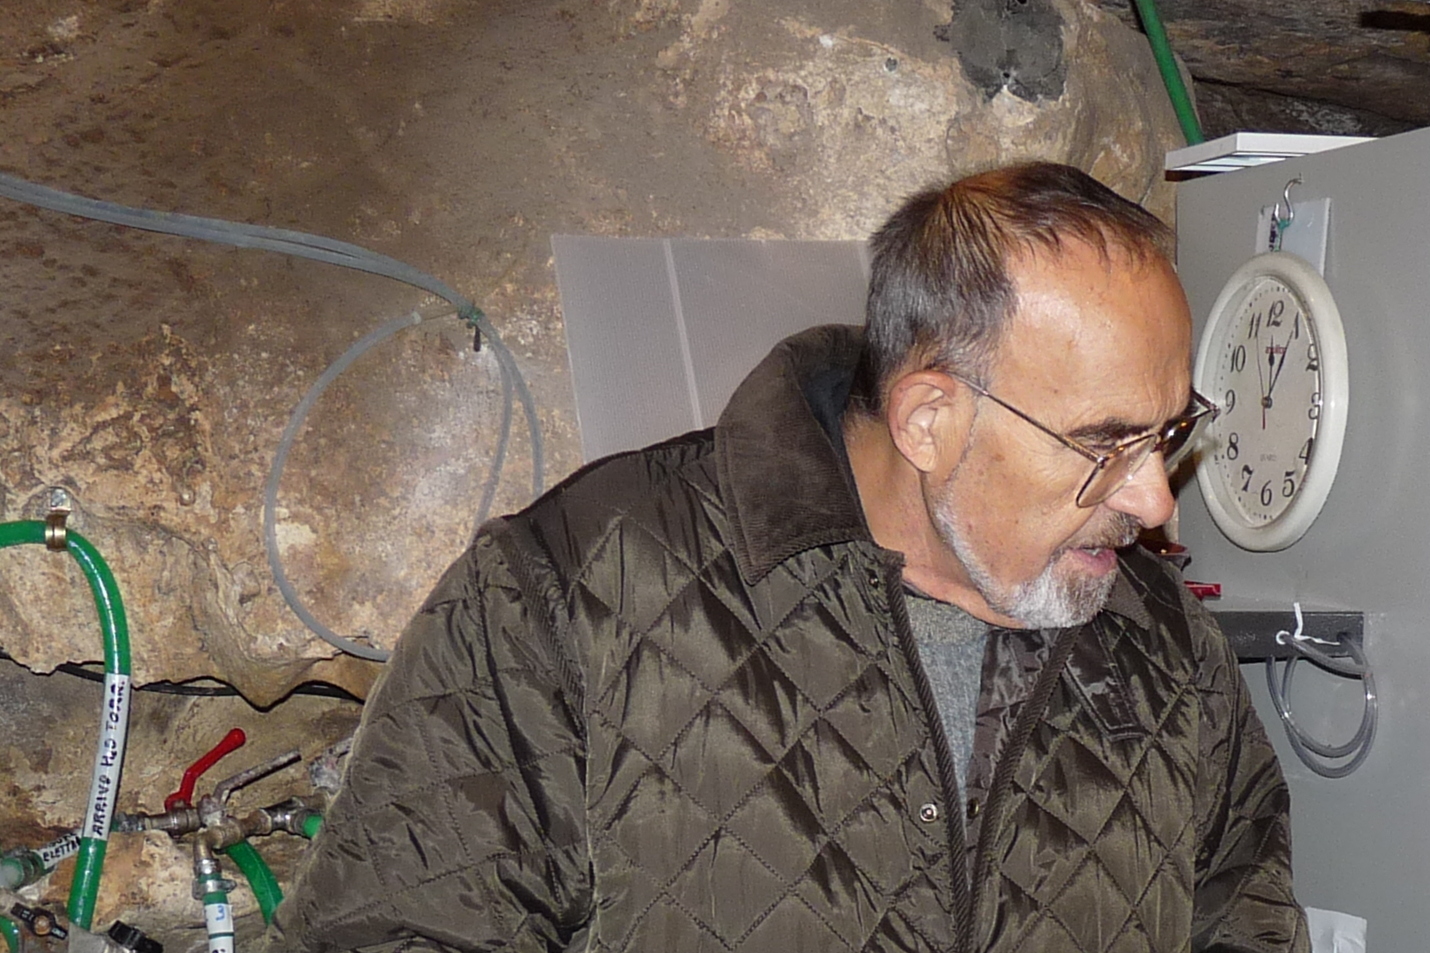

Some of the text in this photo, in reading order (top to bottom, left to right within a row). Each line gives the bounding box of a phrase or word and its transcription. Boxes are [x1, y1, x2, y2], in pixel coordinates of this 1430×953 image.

[1248, 311, 1262, 340] 11
[1267, 300, 1285, 327] 12
[1230, 344, 1247, 373] 10
[1225, 389, 1236, 416] 9
[1226, 432, 1239, 460] 8
[1299, 437, 1314, 465] 4
[1241, 464, 1254, 492] 7
[1282, 470, 1296, 498] 5
[1260, 479, 1273, 506] 6
[92, 774, 111, 836] ARRIVO
